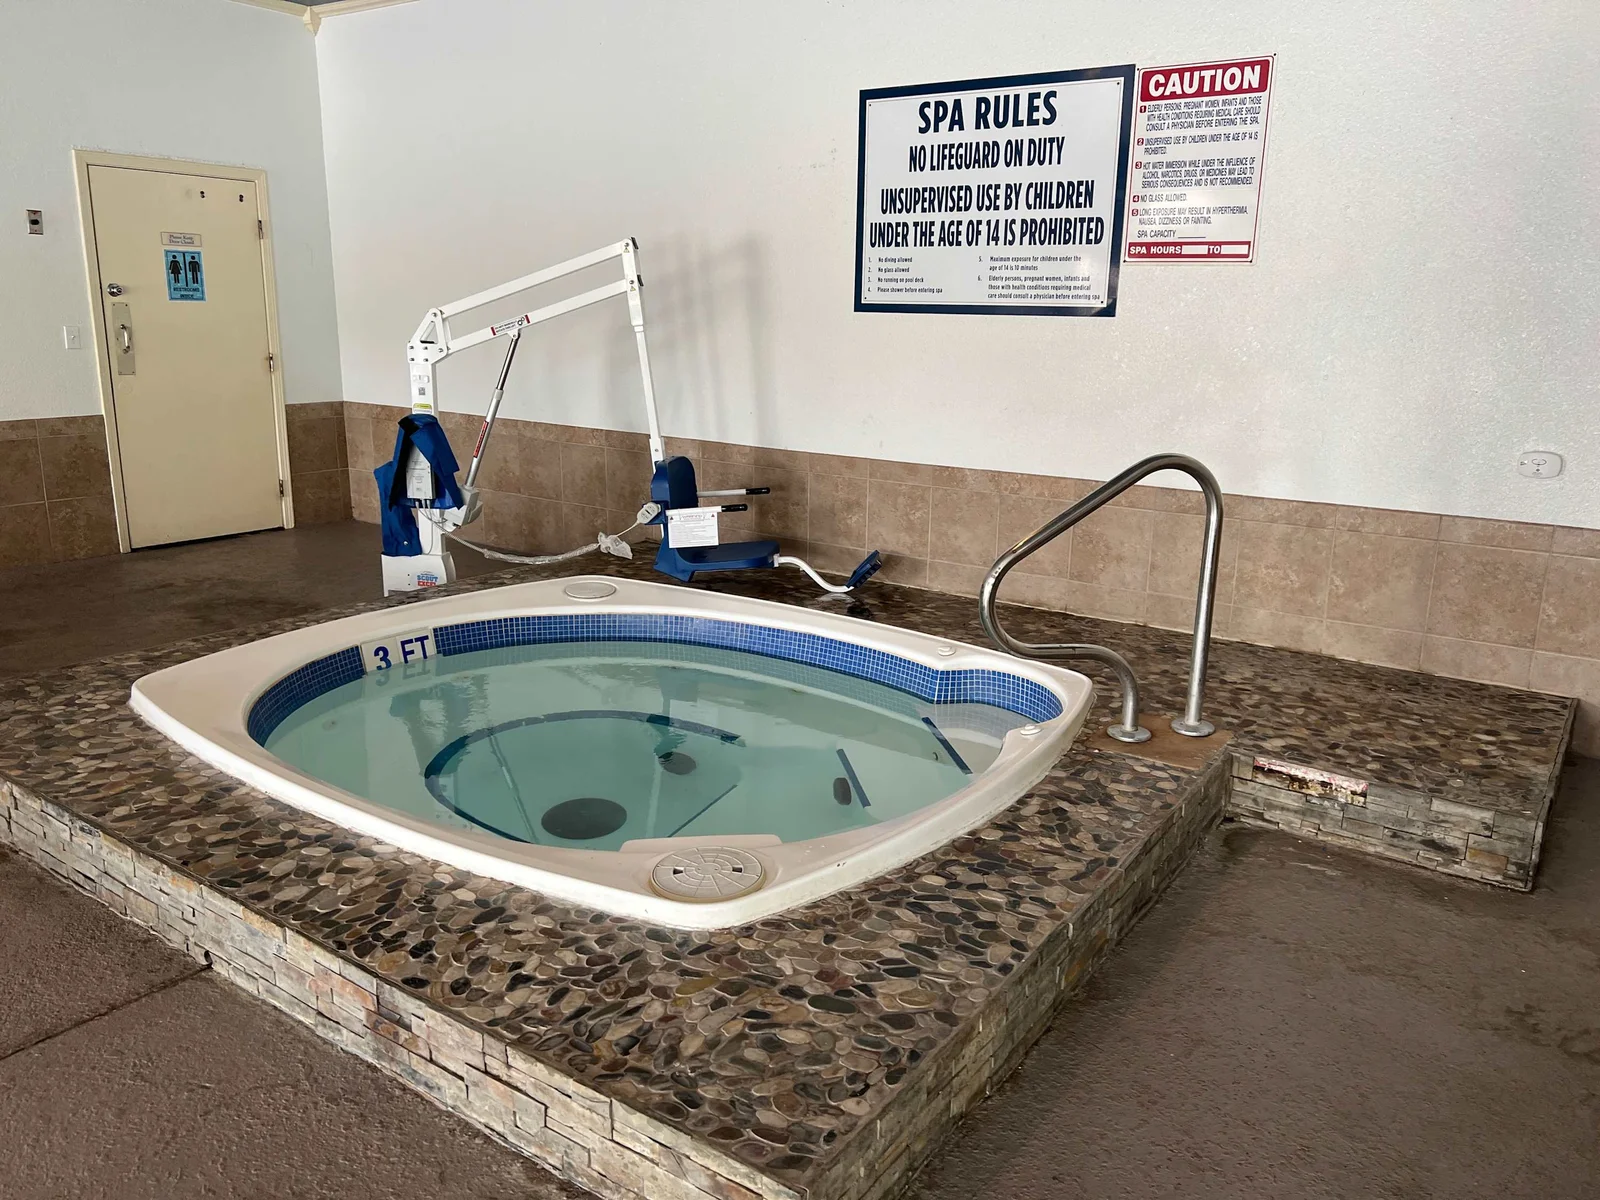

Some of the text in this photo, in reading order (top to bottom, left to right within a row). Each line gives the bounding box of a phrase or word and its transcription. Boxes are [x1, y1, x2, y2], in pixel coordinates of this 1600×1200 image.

[1148, 64, 1260, 97] CAUTION
[1147, 103, 1162, 112] ELDERLY
[1183, 100, 1203, 109] PREGNANT
[1221, 97, 1237, 107] INFANTS
[1238, 97, 1247, 105] AND
[1248, 95, 1262, 105] THOSE
[918, 90, 1058, 134] SPA RULES
[1156, 112, 1169, 121] HEALTH
[1170, 110, 1193, 120] CONDITIONS
[1194, 109, 1214, 118] REQUIRING
[1215, 108, 1232, 117] MEDICAL
[1232, 106, 1243, 116] CARE
[1244, 105, 1260, 115] SHOULD
[1145, 122, 1165, 131] CONSULT
[1166, 122, 1171, 130] A
[1171, 120, 1194, 129] PHYSICIAN
[1195, 119, 1213, 128] BEFORE
[1214, 117, 1237, 126] ENTERING
[1238, 116, 1248, 125] THE
[1145, 136, 1172, 146] UNSUPERVISED
[1173, 136, 1181, 144] USE
[1182, 135, 1187, 143] BY
[1188, 134, 1207, 143] CHILDREN
[1208, 133, 1221, 142] UNDER
[1222, 133, 1230, 141] THE
[1231, 132, 1240, 141] AGE
[1240, 132, 1247, 140] OF
[1253, 131, 1258, 139] IS
[909, 136, 1064, 172] NO LIFEGUARD ON DUTY
[1151, 161, 1164, 169] WATER
[1188, 159, 1200, 167] WHILE
[1201, 158, 1215, 167] UNDER
[1216, 158, 1224, 166] THE
[1225, 157, 1248, 166] INFLUENCE
[1248, 156, 1255, 165] OF
[1198, 168, 1205, 177] OR
[1205, 167, 1227, 176] MEDICINES
[1237, 166, 1247, 175] LEAD
[1248, 166, 1254, 175] TO
[1141, 180, 1158, 188] SERIOUS
[1159, 178, 1192, 187] CONSEQUENCES
[1194, 178, 1202, 186] AND
[1203, 178, 1208, 186] IS
[1209, 177, 1218, 185] NOT
[880, 179, 1094, 214] UNSUPERVISED USE BY CHILDREN
[1140, 194, 1147, 202] NO
[1148, 194, 1163, 202] GLASS
[1139, 208, 1151, 216] LONG
[1152, 207, 1176, 215] EXPOSURE
[1188, 206, 1204, 215] RESULT
[1158, 216, 1181, 225] DIZZINESS
[1182, 216, 1189, 224] OR
[870, 216, 1104, 247] UNDER THE AGE OF 14 IS PROHIBITED
[1137, 229, 1176, 238] SPA CAPACITY
[1208, 245, 1220, 253] TO
[417, 574, 438, 582] SCOUT
[374, 634, 429, 670] 3 FT
